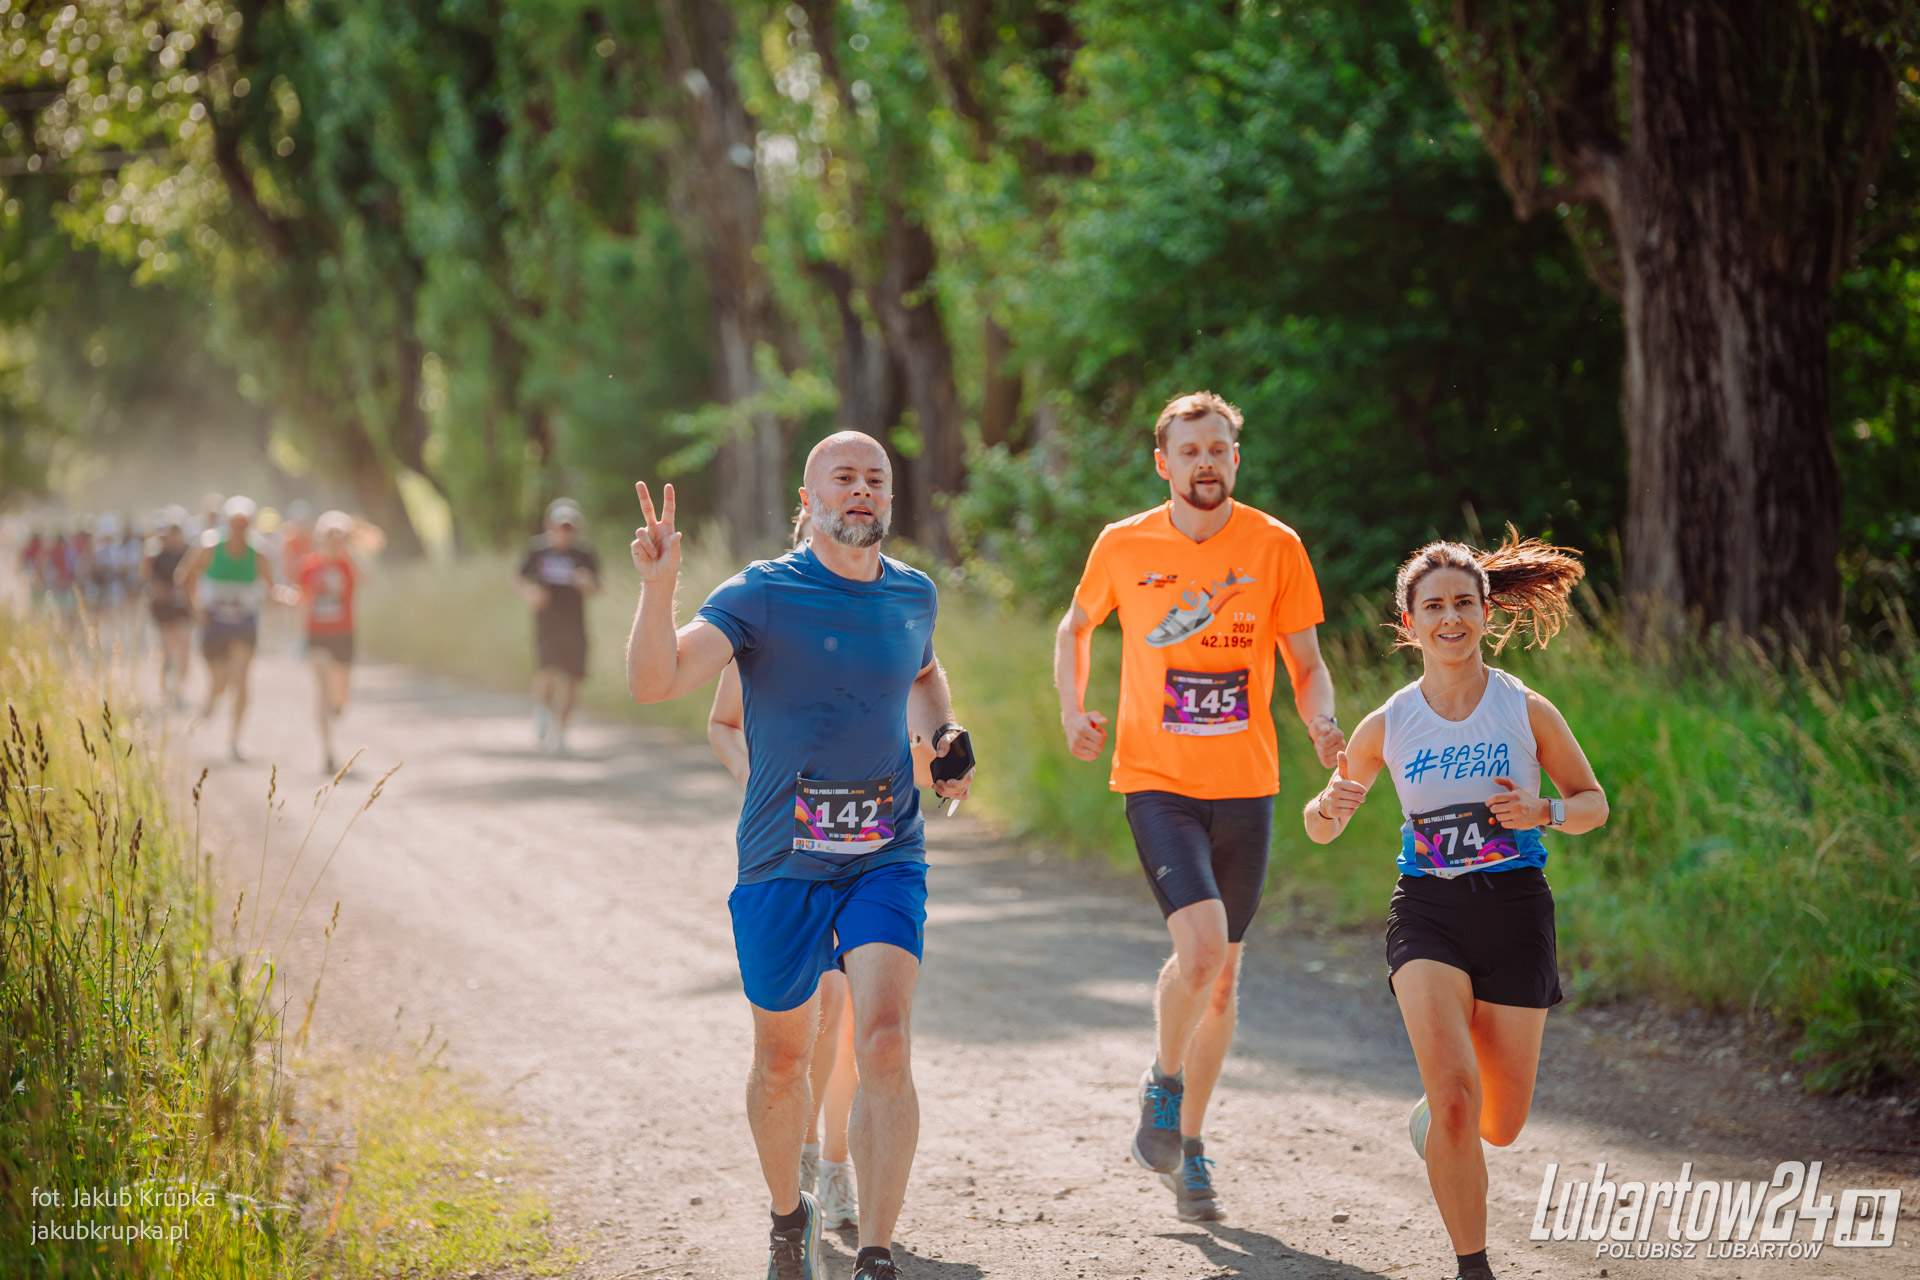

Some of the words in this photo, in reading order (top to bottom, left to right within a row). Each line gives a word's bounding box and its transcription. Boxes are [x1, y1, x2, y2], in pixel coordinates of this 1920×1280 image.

[1182, 687, 1238, 714] 145
[1440, 760, 1510, 780] TEAM
[815, 799, 879, 828] 142
[1439, 822, 1485, 856] 74
